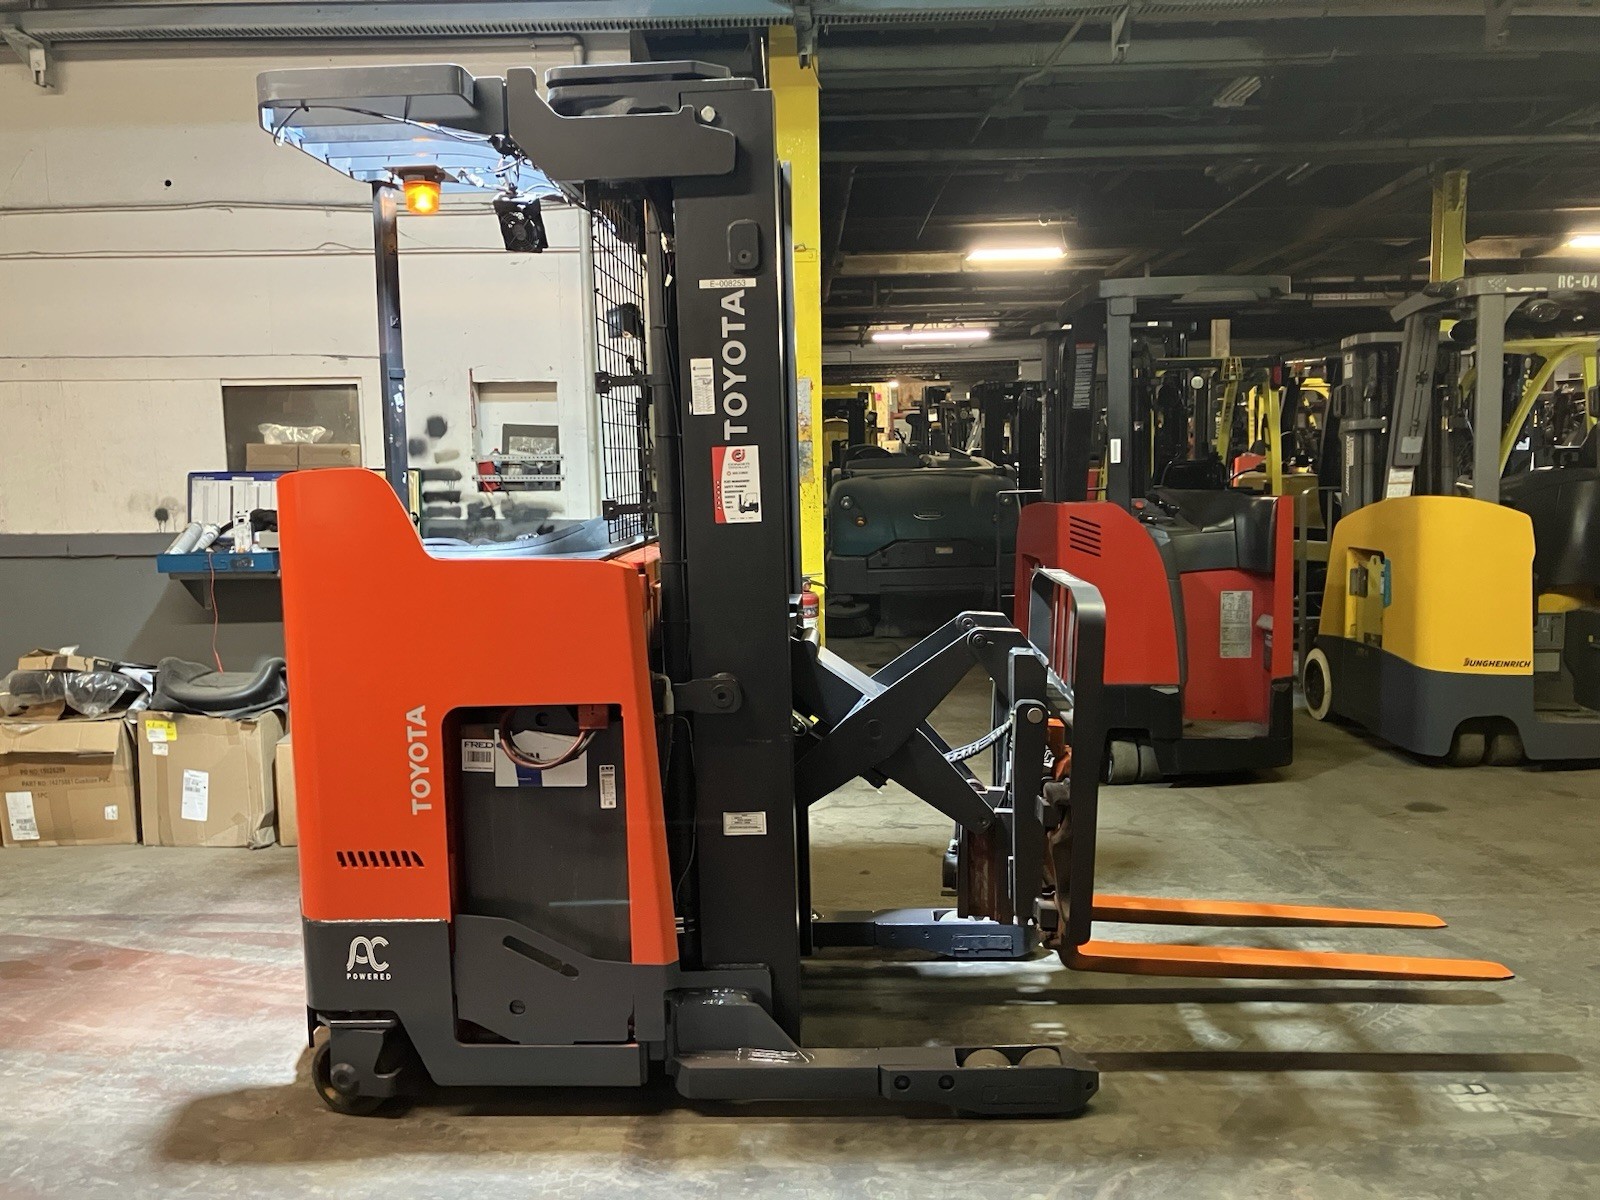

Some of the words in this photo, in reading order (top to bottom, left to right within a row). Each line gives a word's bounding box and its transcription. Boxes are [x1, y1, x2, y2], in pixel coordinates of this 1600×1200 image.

[709, 279, 746, 288] E-008253
[1557, 274, 1599, 289] RC-04
[720, 289, 748, 441] TOYOTA
[1463, 657, 1531, 668] JUNGHEINRICH
[464, 741, 494, 749] FRED
[405, 704, 433, 816] TOYOTA
[346, 935, 390, 972] AC
[346, 972, 392, 981] POWERED
